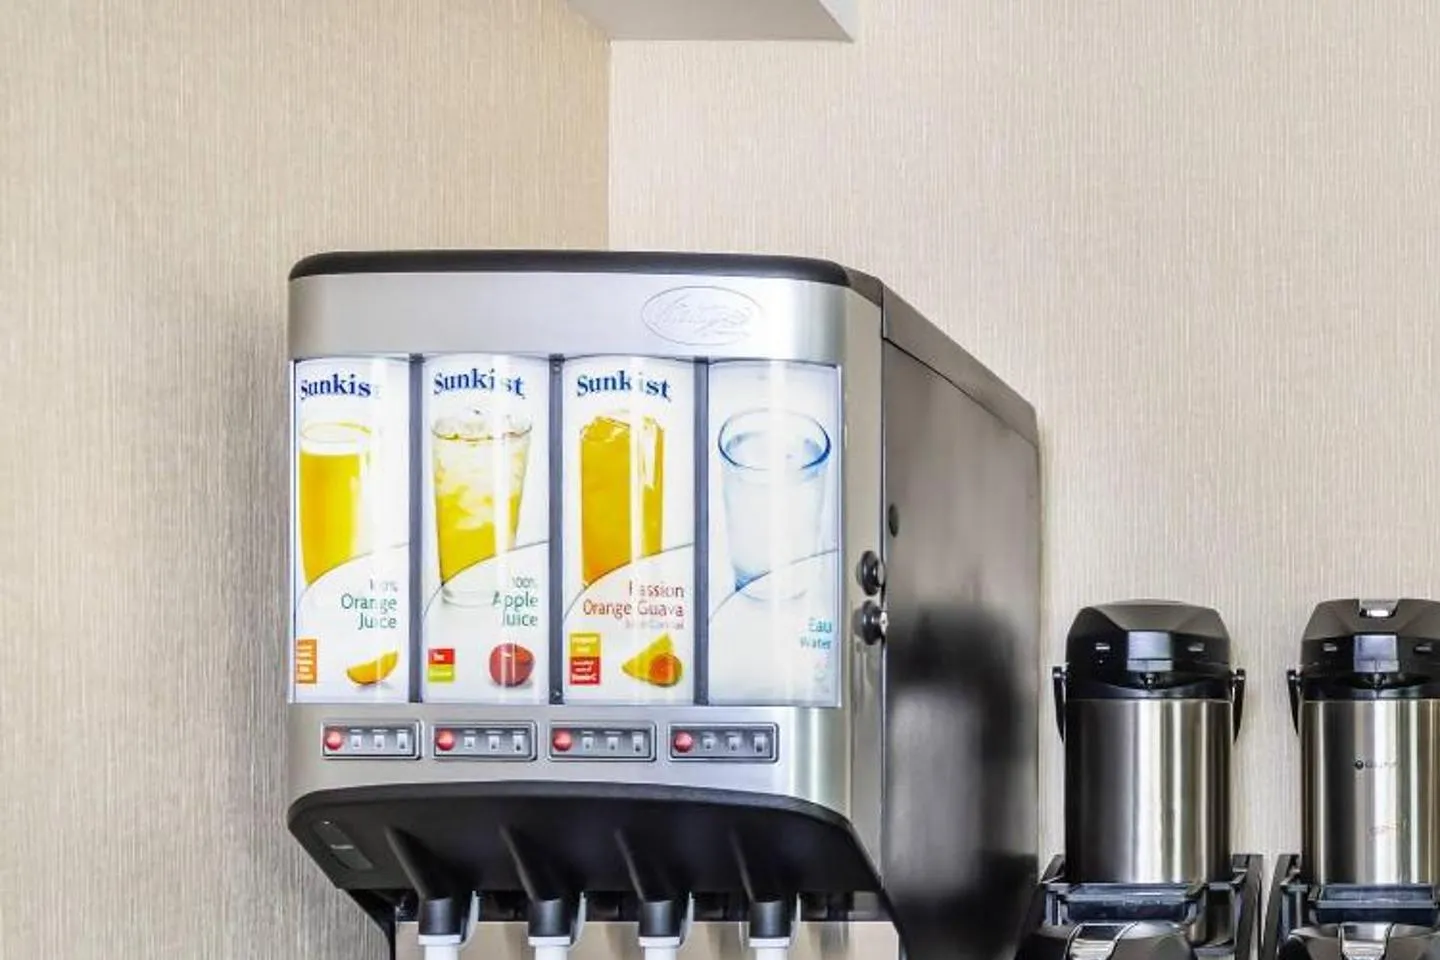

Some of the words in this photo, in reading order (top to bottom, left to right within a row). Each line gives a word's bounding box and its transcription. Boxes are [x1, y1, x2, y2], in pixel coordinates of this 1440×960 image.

[300, 373, 379, 400] Sunkis
[492, 590, 538, 613] Apple
[583, 599, 632, 619] Orange
[808, 616, 832, 633] Eau
